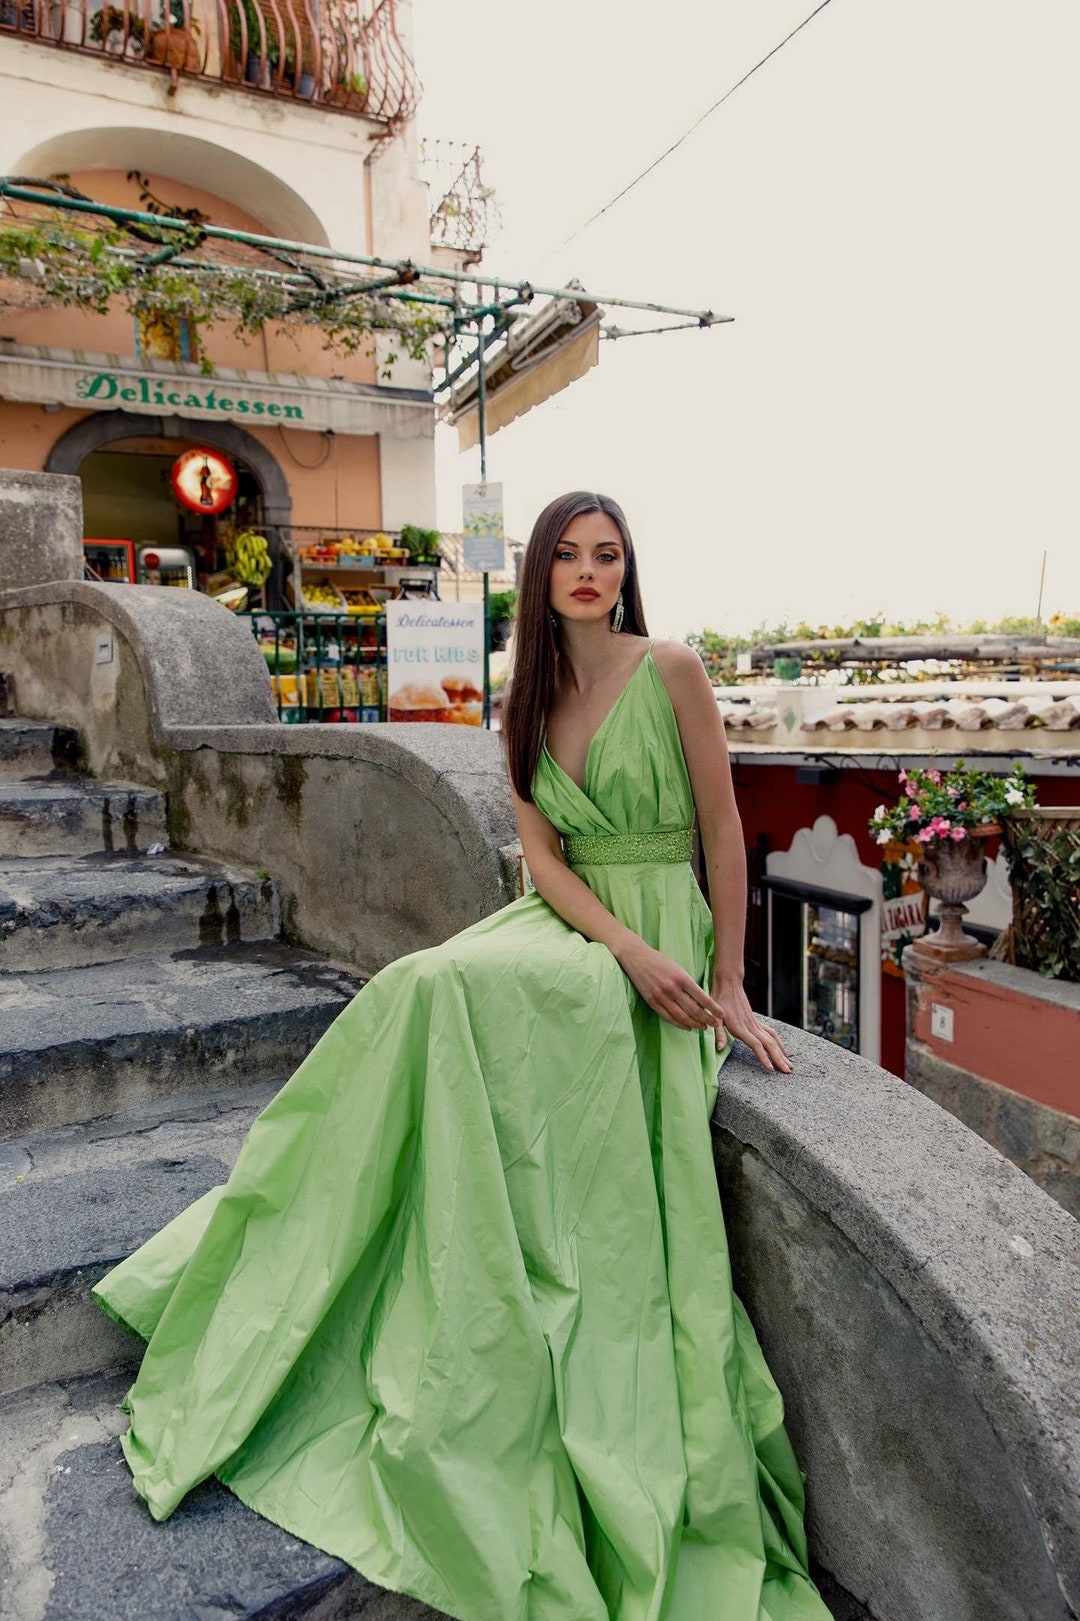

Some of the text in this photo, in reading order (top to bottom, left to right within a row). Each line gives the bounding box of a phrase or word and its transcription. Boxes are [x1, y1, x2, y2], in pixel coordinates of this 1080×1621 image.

[76, 374, 304, 419] Delicatessen
[396, 614, 474, 628] Delicatessen
[393, 647, 479, 663] FOR KIDS
